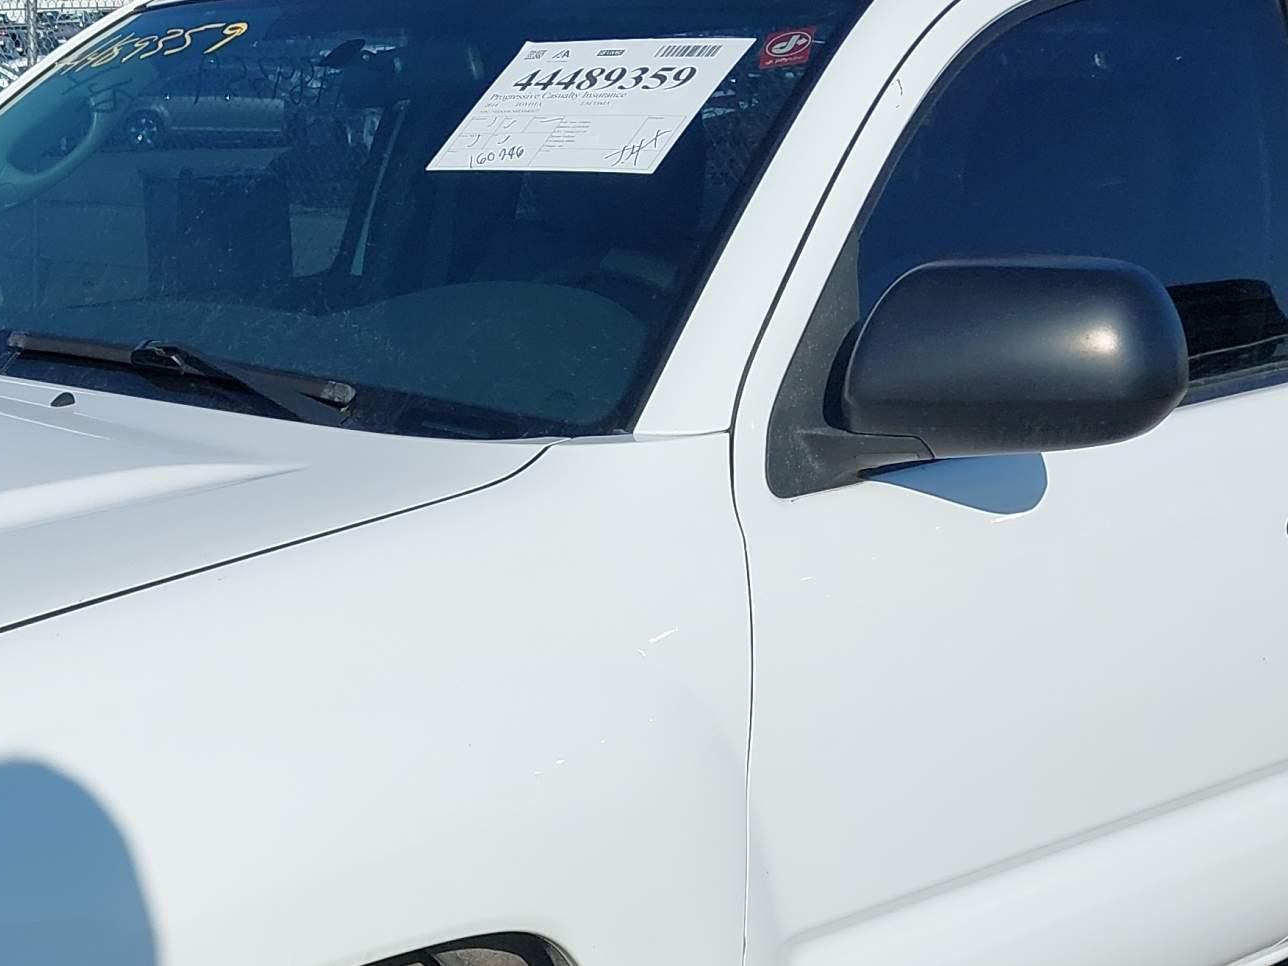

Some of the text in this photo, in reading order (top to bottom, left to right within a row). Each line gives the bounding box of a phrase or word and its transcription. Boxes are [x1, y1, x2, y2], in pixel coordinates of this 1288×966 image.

[513, 66, 697, 92] 44489359
[542, 91, 579, 99] Casualty
[582, 91, 627, 99] Insurance
